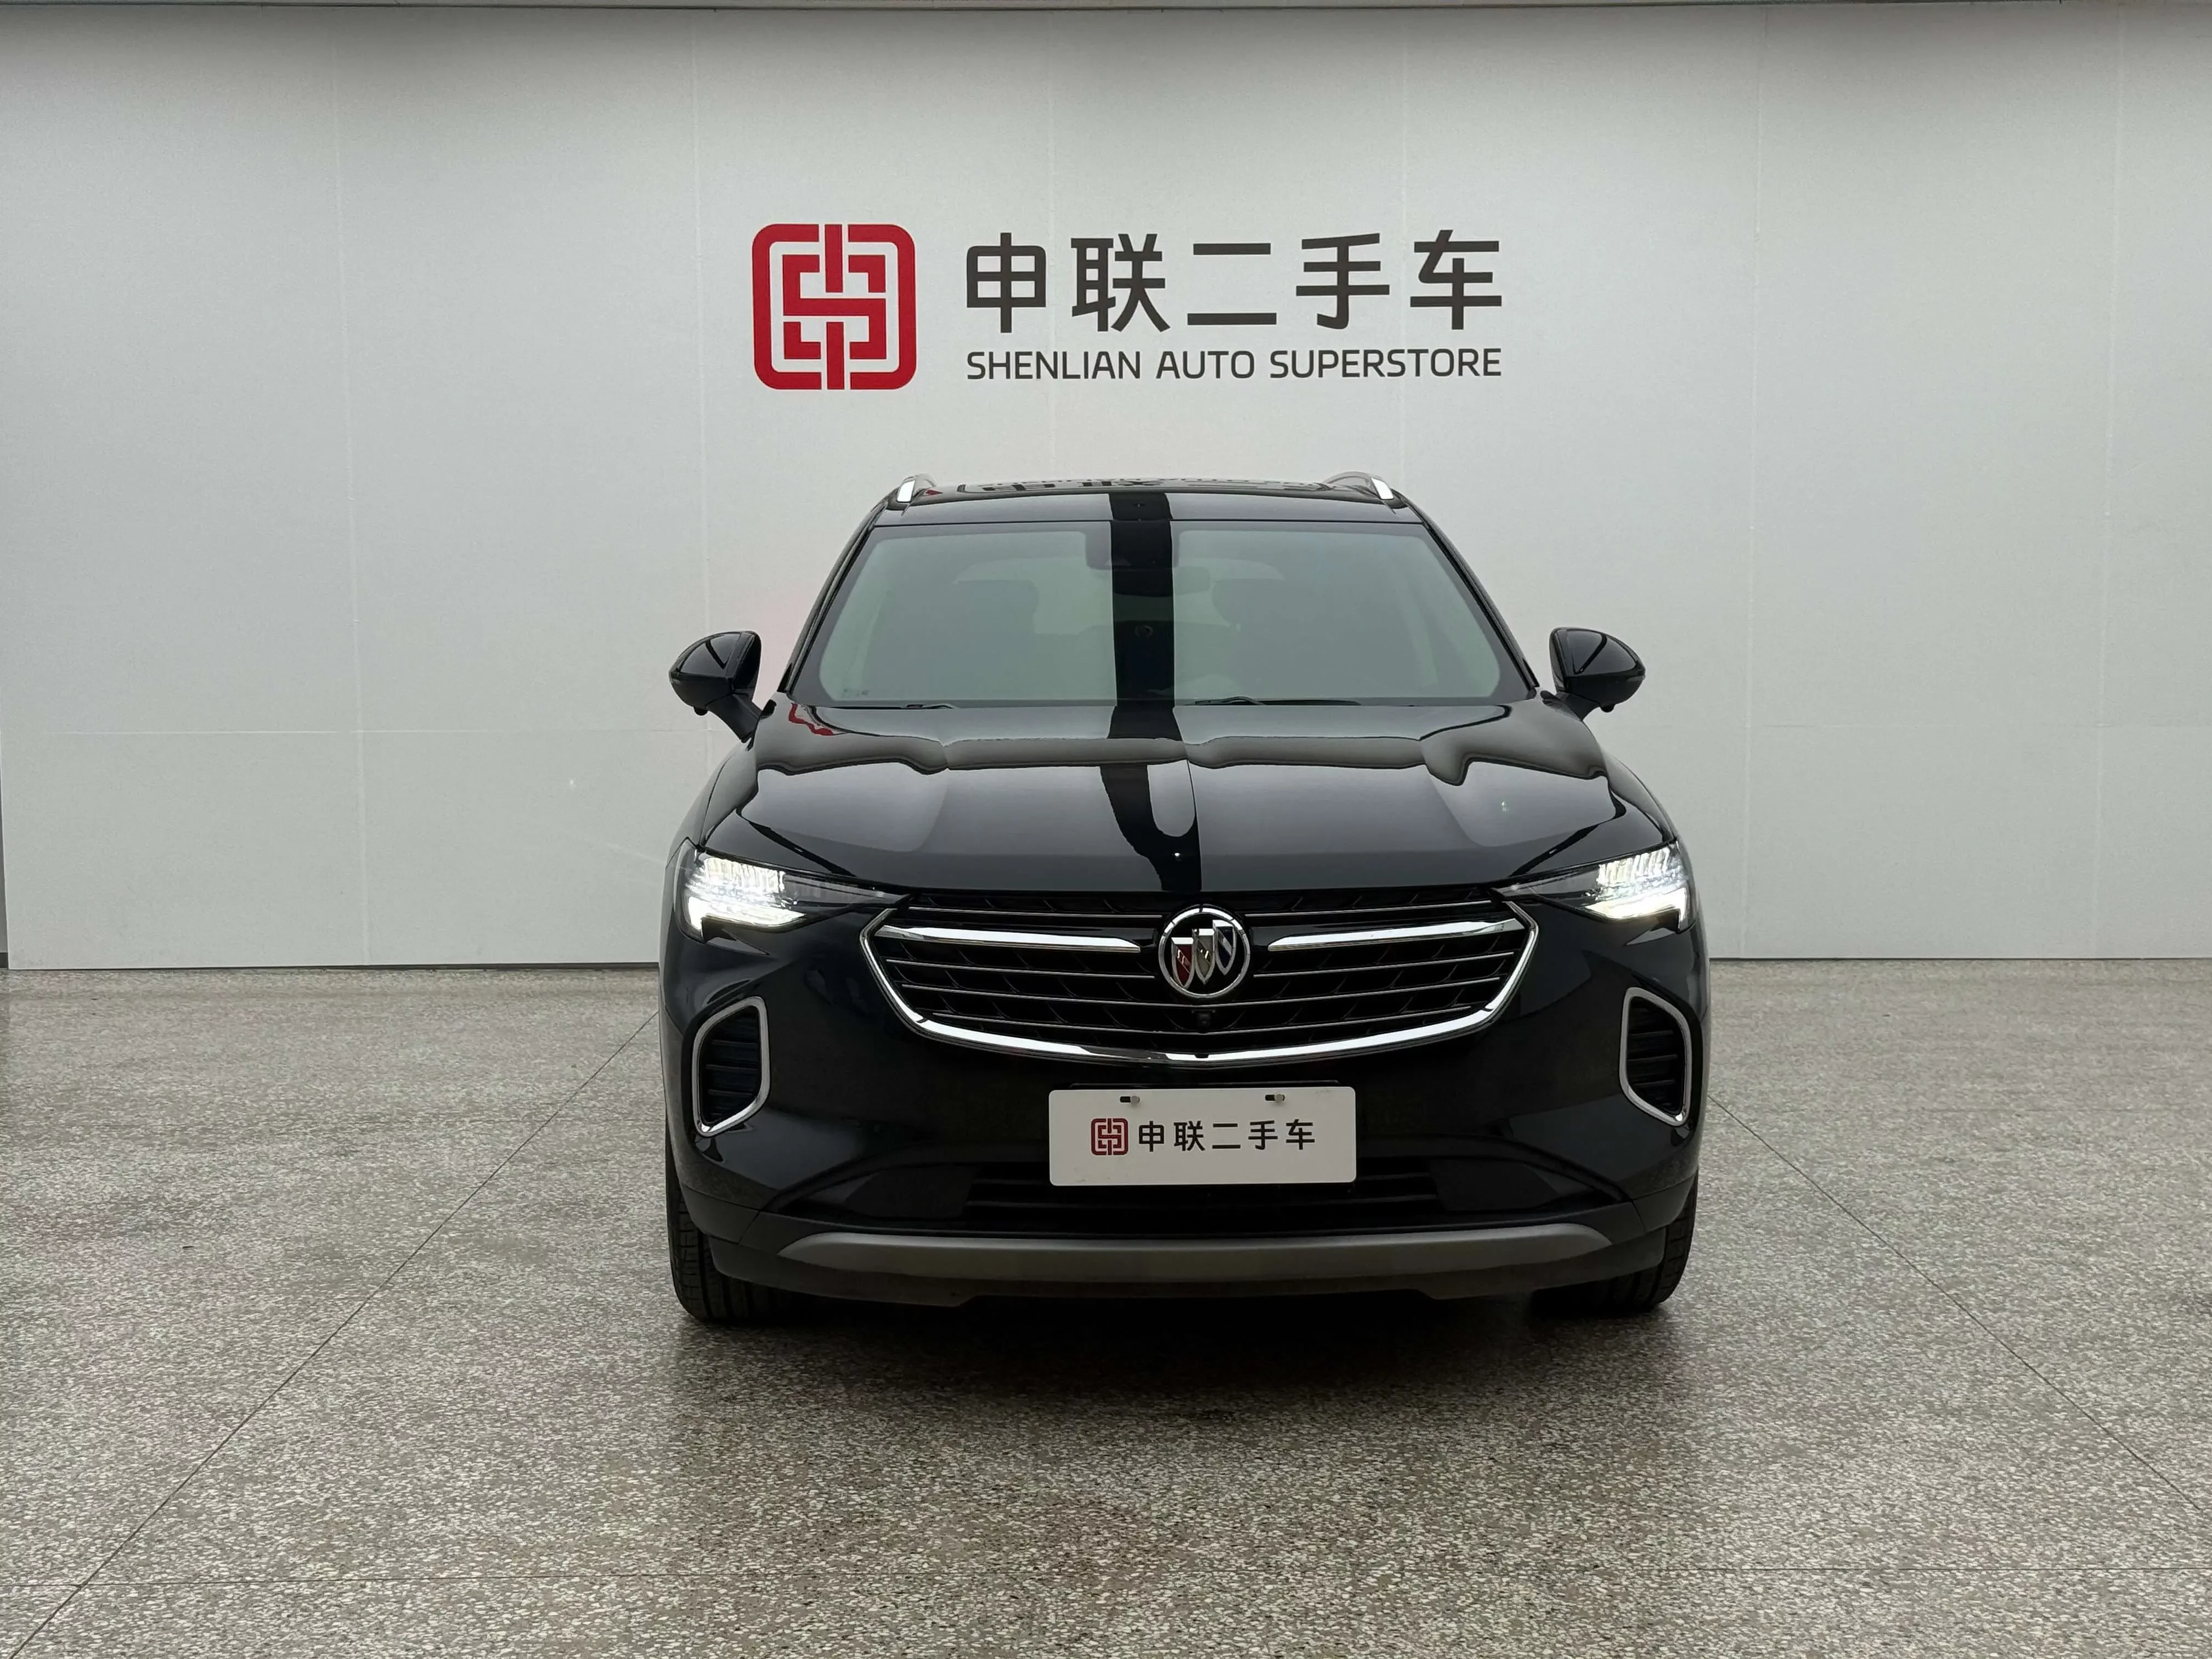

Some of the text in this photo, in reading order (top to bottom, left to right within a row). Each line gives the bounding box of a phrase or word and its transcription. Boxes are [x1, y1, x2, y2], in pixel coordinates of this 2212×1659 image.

[967, 230, 1502, 334] 申联二手车
[967, 348, 1502, 380] SHENLIAN AUTO SUPERSTORE
[1138, 1119, 1316, 1152] 申联二手车
